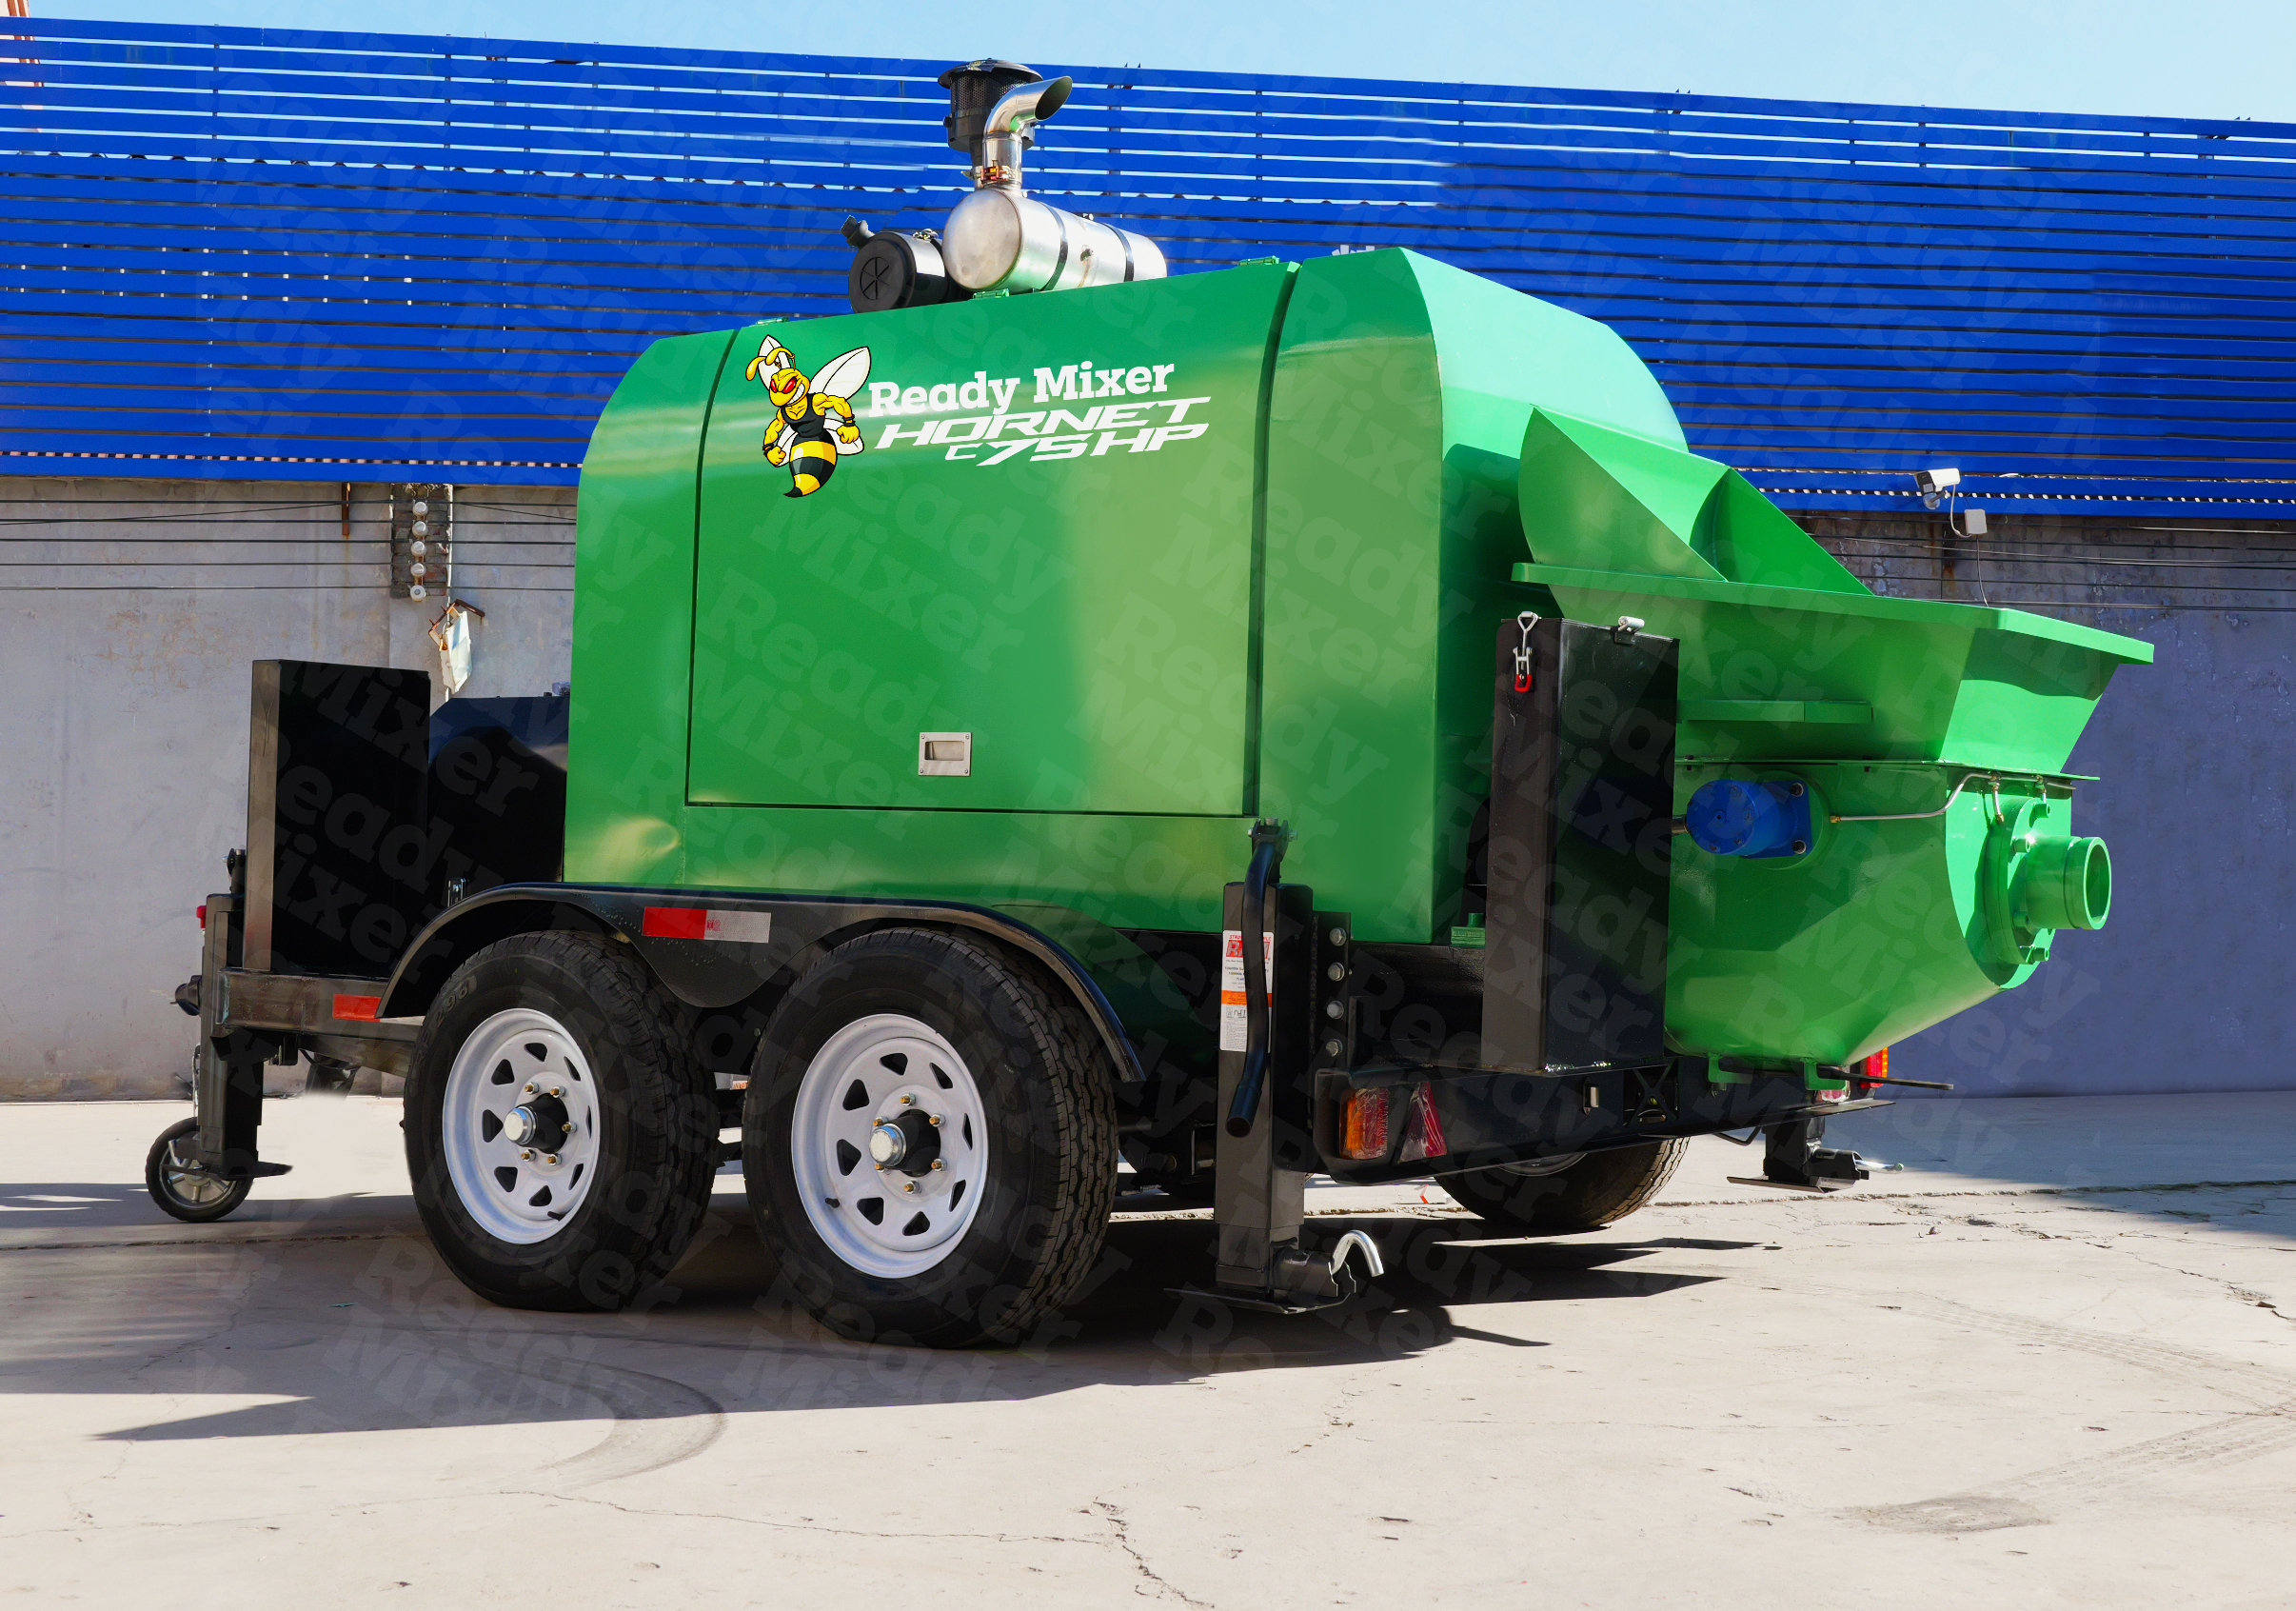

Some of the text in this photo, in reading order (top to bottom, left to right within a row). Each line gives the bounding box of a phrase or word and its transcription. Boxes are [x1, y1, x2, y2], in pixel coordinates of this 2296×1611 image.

[868, 360, 1175, 417] Ready Mixer
[875, 396, 1212, 449] HORNET
